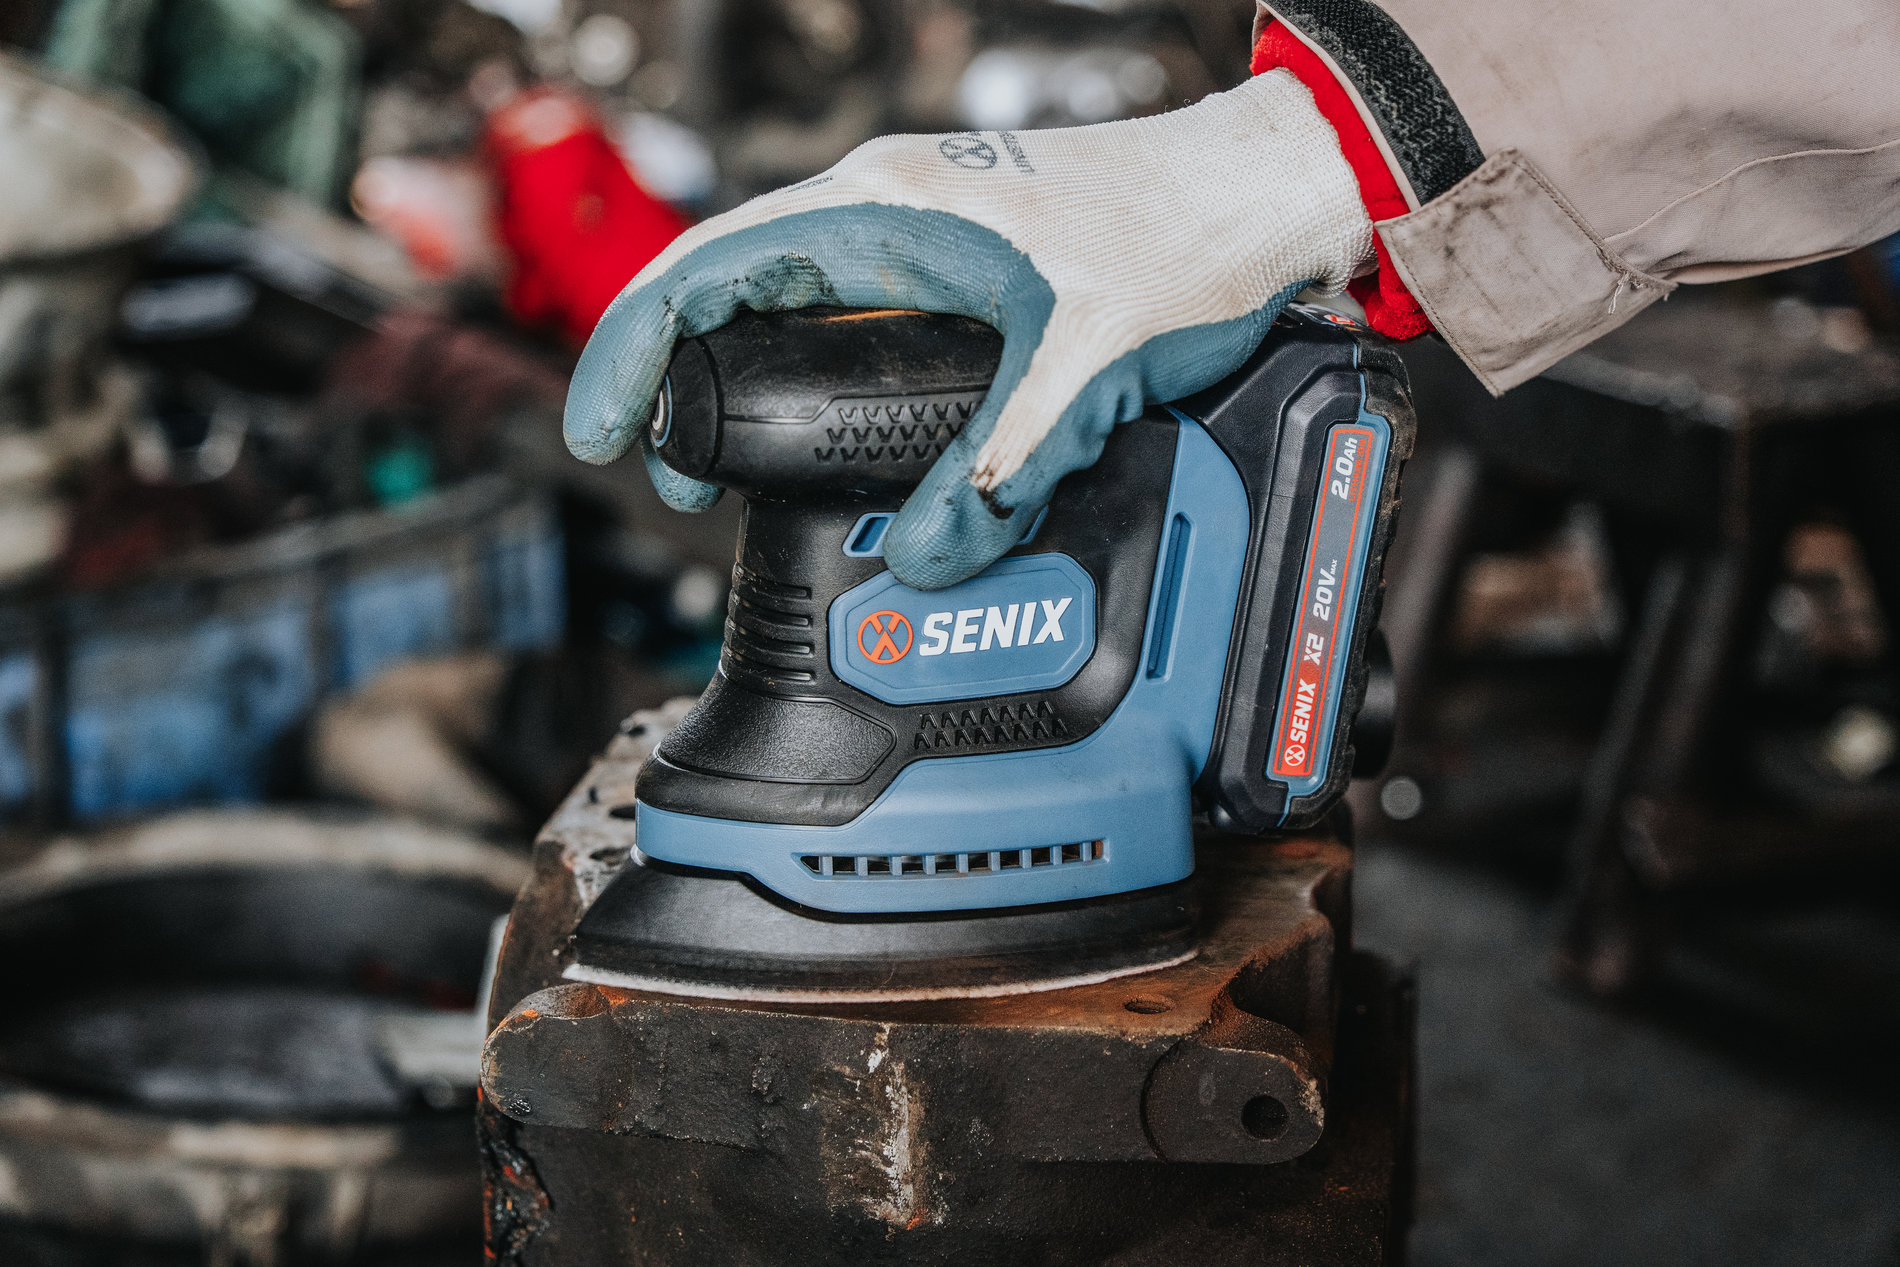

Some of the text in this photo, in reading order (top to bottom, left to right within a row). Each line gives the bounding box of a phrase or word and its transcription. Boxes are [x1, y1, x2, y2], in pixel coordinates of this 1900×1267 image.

[1348, 439, 1367, 502] LITHIUM ION
[1289, 678, 1316, 744] SENIX
[1303, 632, 1325, 666] X2
[1331, 437, 1358, 500] 2.0Ah
[919, 597, 1073, 656] SENIX
